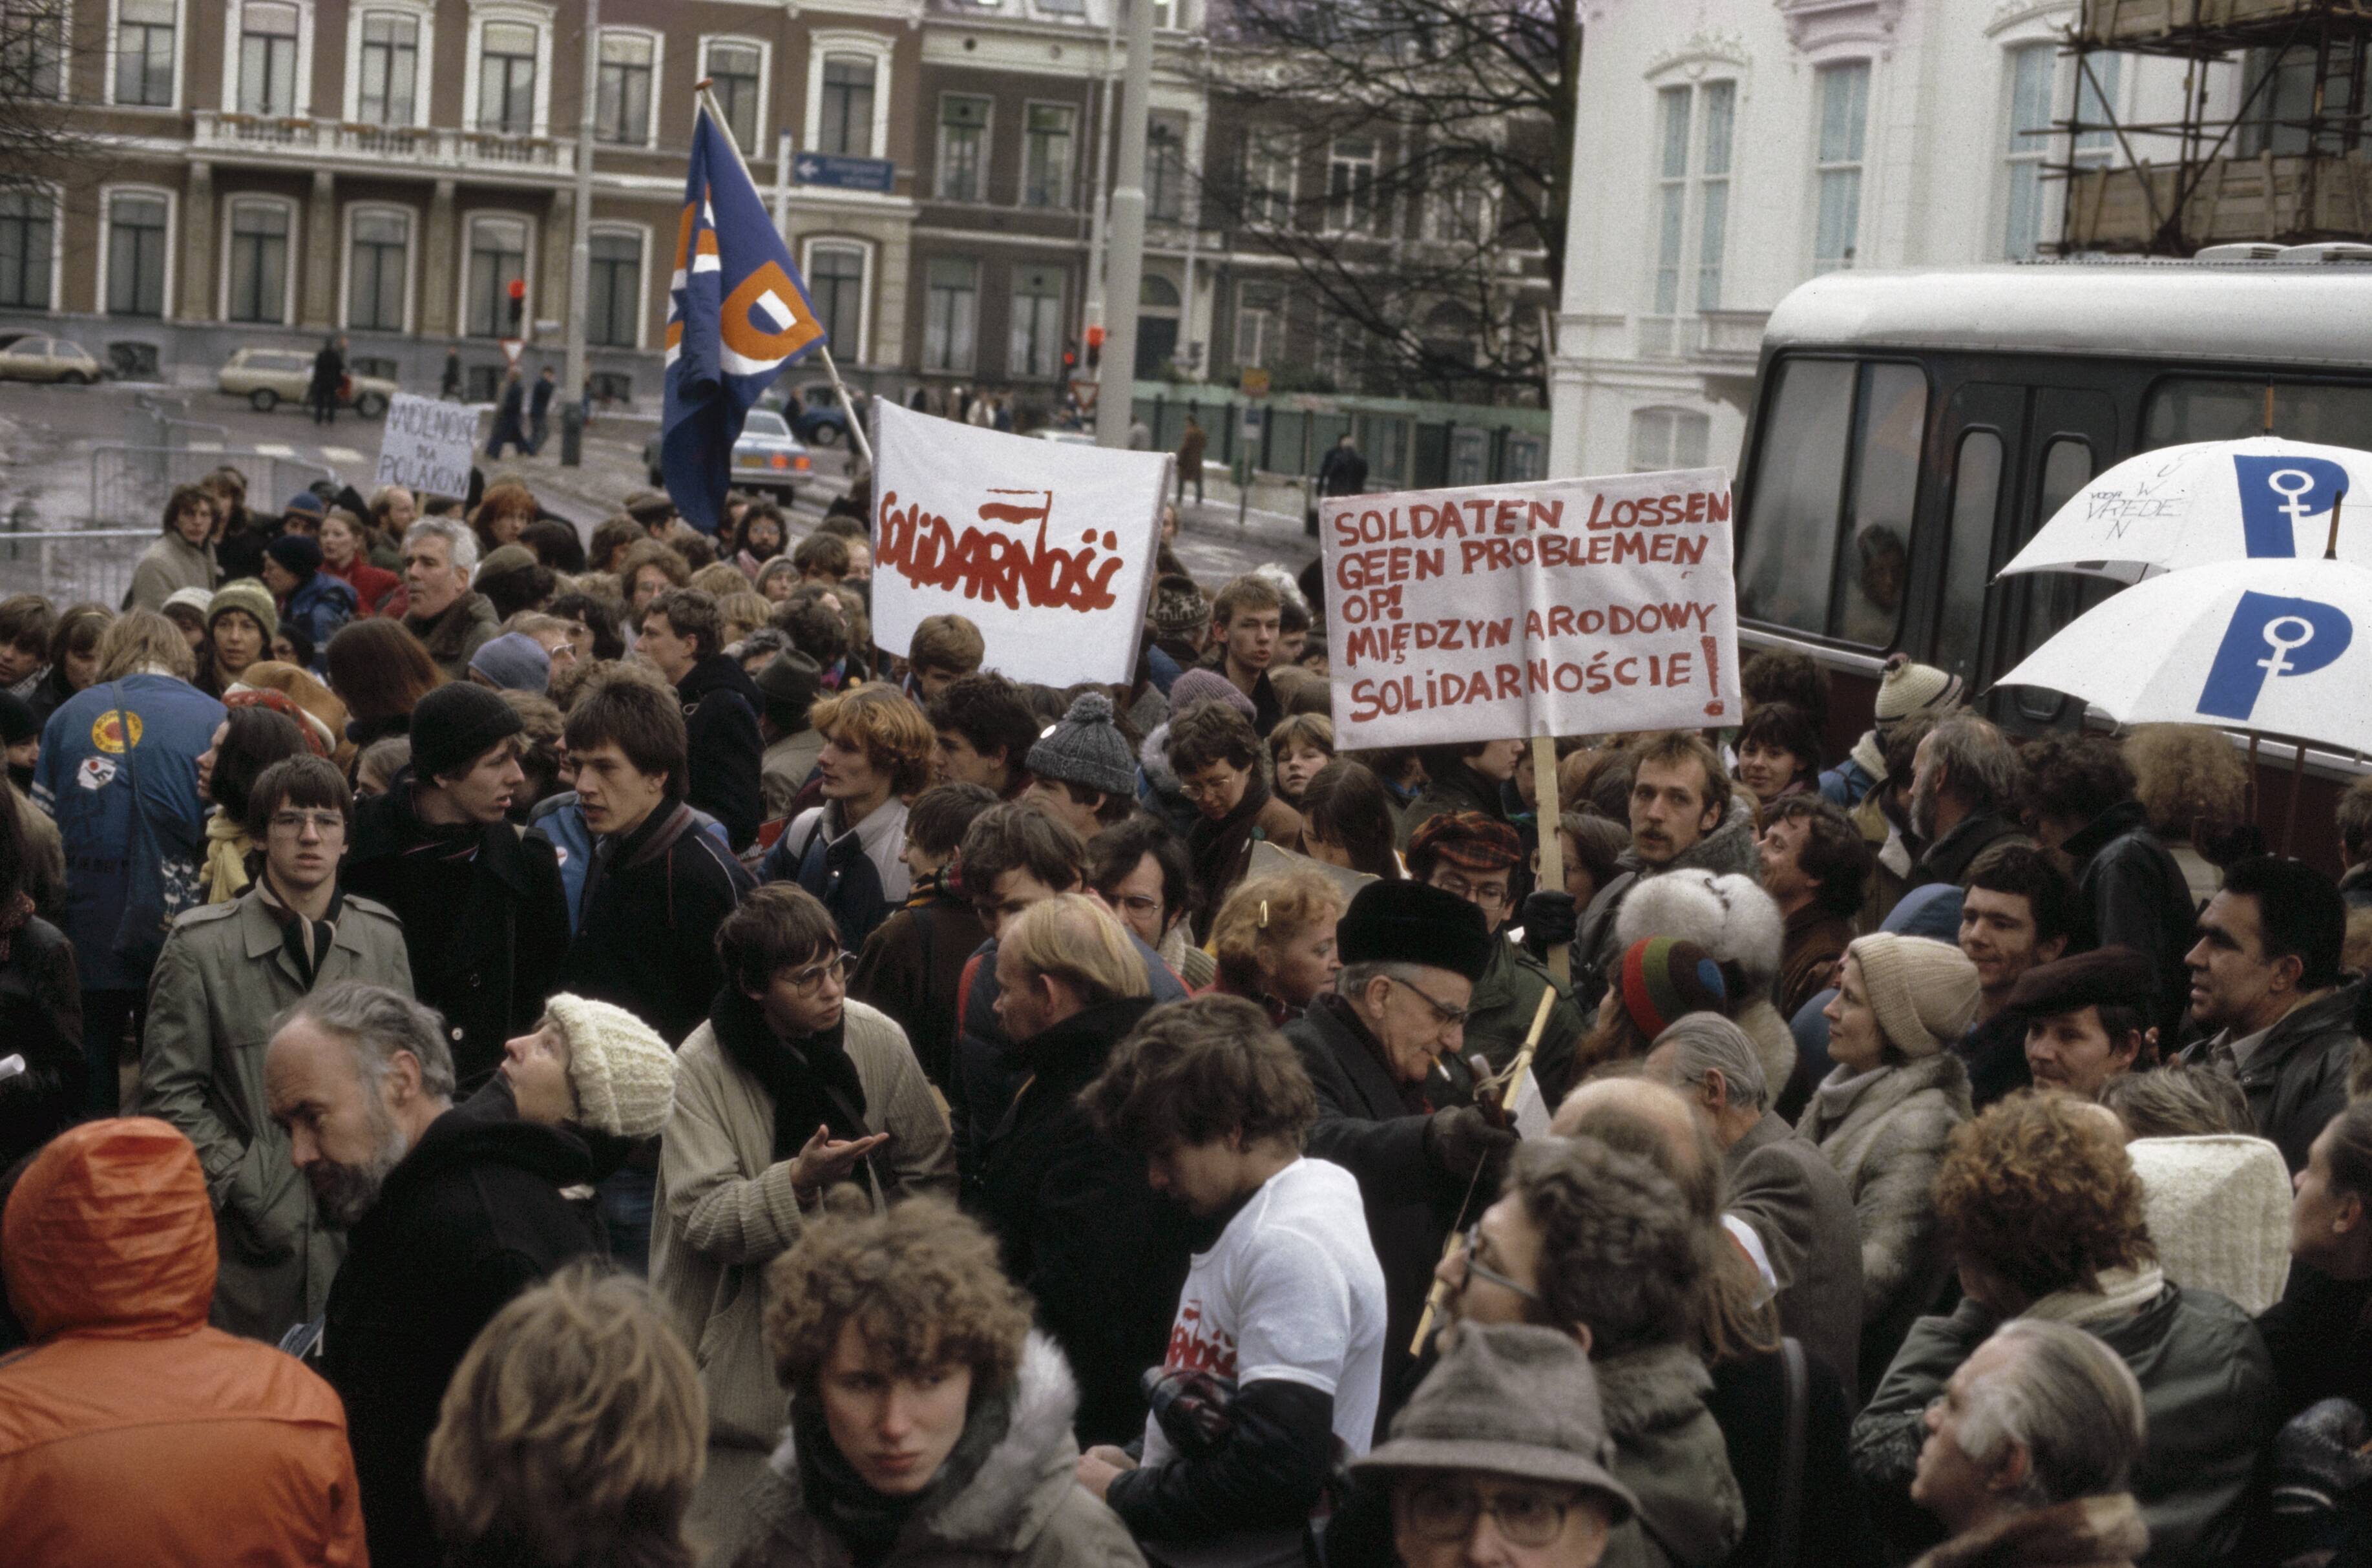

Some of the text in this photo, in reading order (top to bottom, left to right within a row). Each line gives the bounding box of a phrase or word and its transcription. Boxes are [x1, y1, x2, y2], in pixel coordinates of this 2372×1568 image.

[1335, 493, 1730, 547] SOLDATEN LOSSEN
[1338, 533, 1708, 590] GEEN PROBLEMEN
[1343, 585, 1403, 622] OP!
